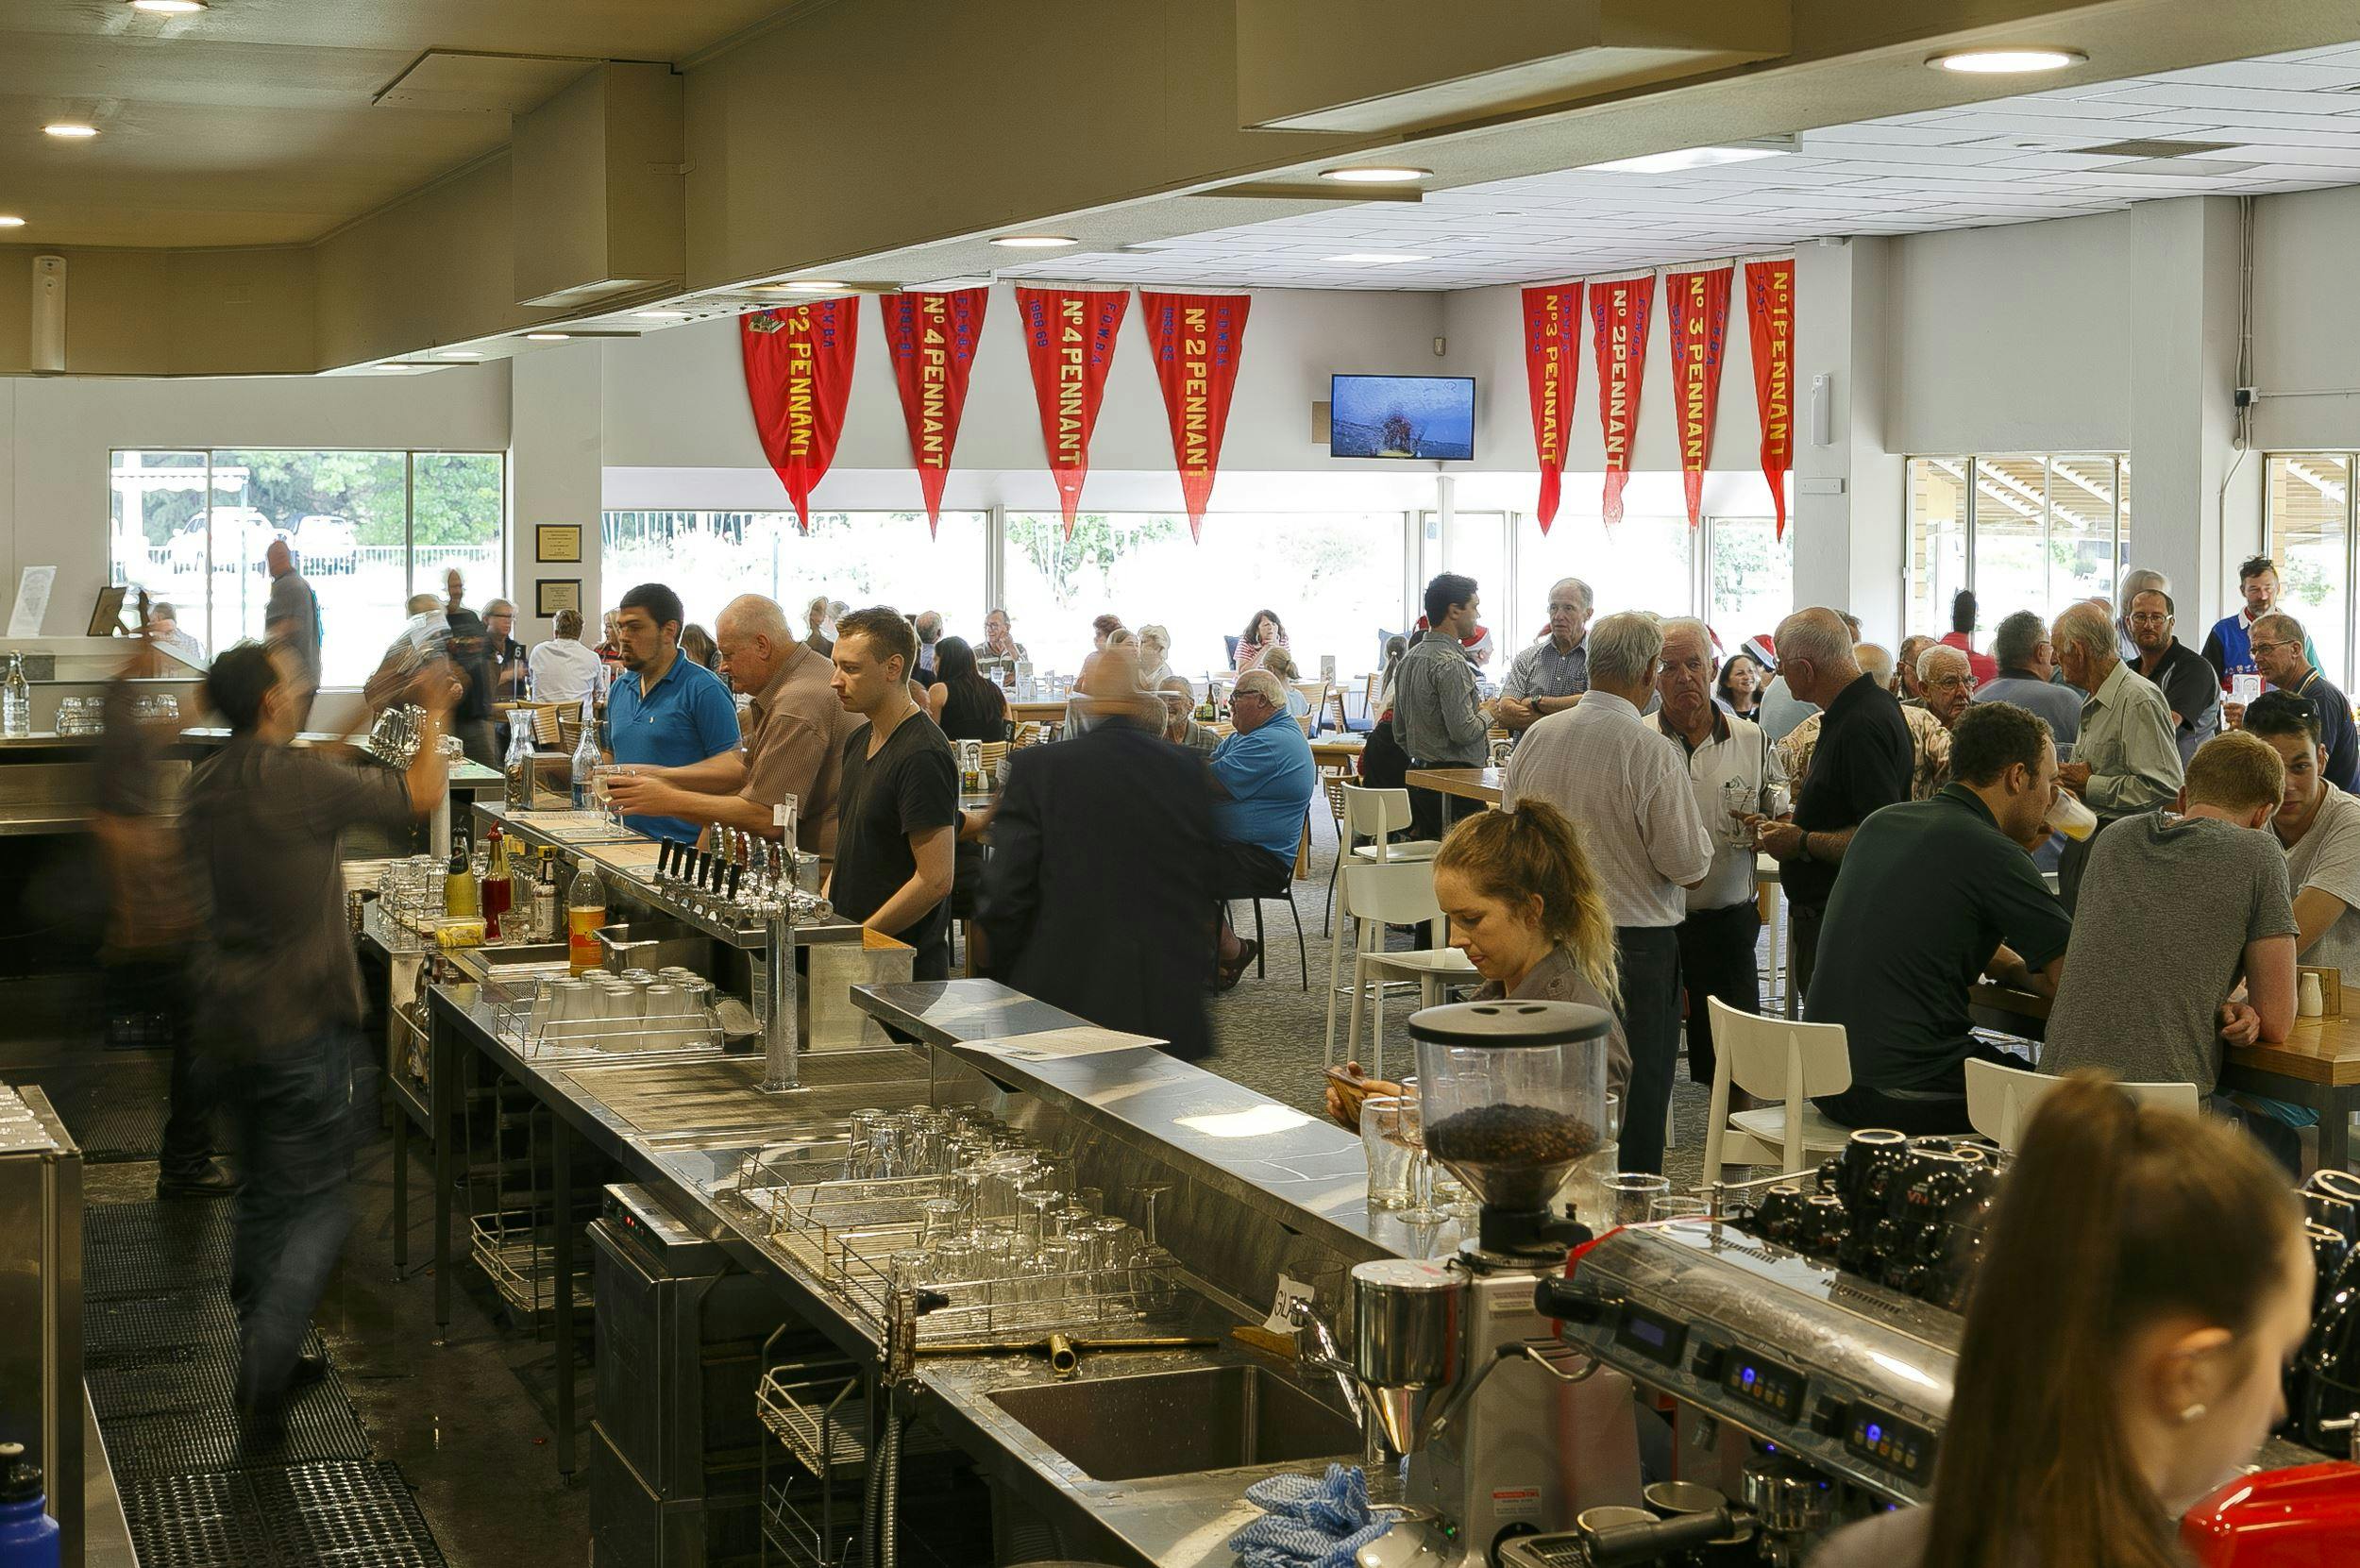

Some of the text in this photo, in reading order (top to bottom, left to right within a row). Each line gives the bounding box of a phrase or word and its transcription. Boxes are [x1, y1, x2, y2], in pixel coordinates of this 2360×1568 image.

[788, 317, 810, 335] 2
[923, 328, 945, 345] 4
[1061, 327, 1083, 343] 4
[1185, 338, 1206, 356] 2
[1545, 322, 1559, 337] 3
[1612, 325, 1627, 344] 2
[1689, 316, 1705, 336] 3
[789, 343, 812, 456] PENNANT
[922, 347, 945, 469] PENNANT
[1058, 347, 1083, 466] PENNANT
[1186, 362, 1208, 479] PENNANT
[1541, 346, 1559, 464] PENNANT
[1606, 344, 1627, 470] PENNANT
[1686, 342, 1705, 475] PENNANT
[1769, 320, 1788, 455] PENNANT
[514, 646, 522, 658] 6
